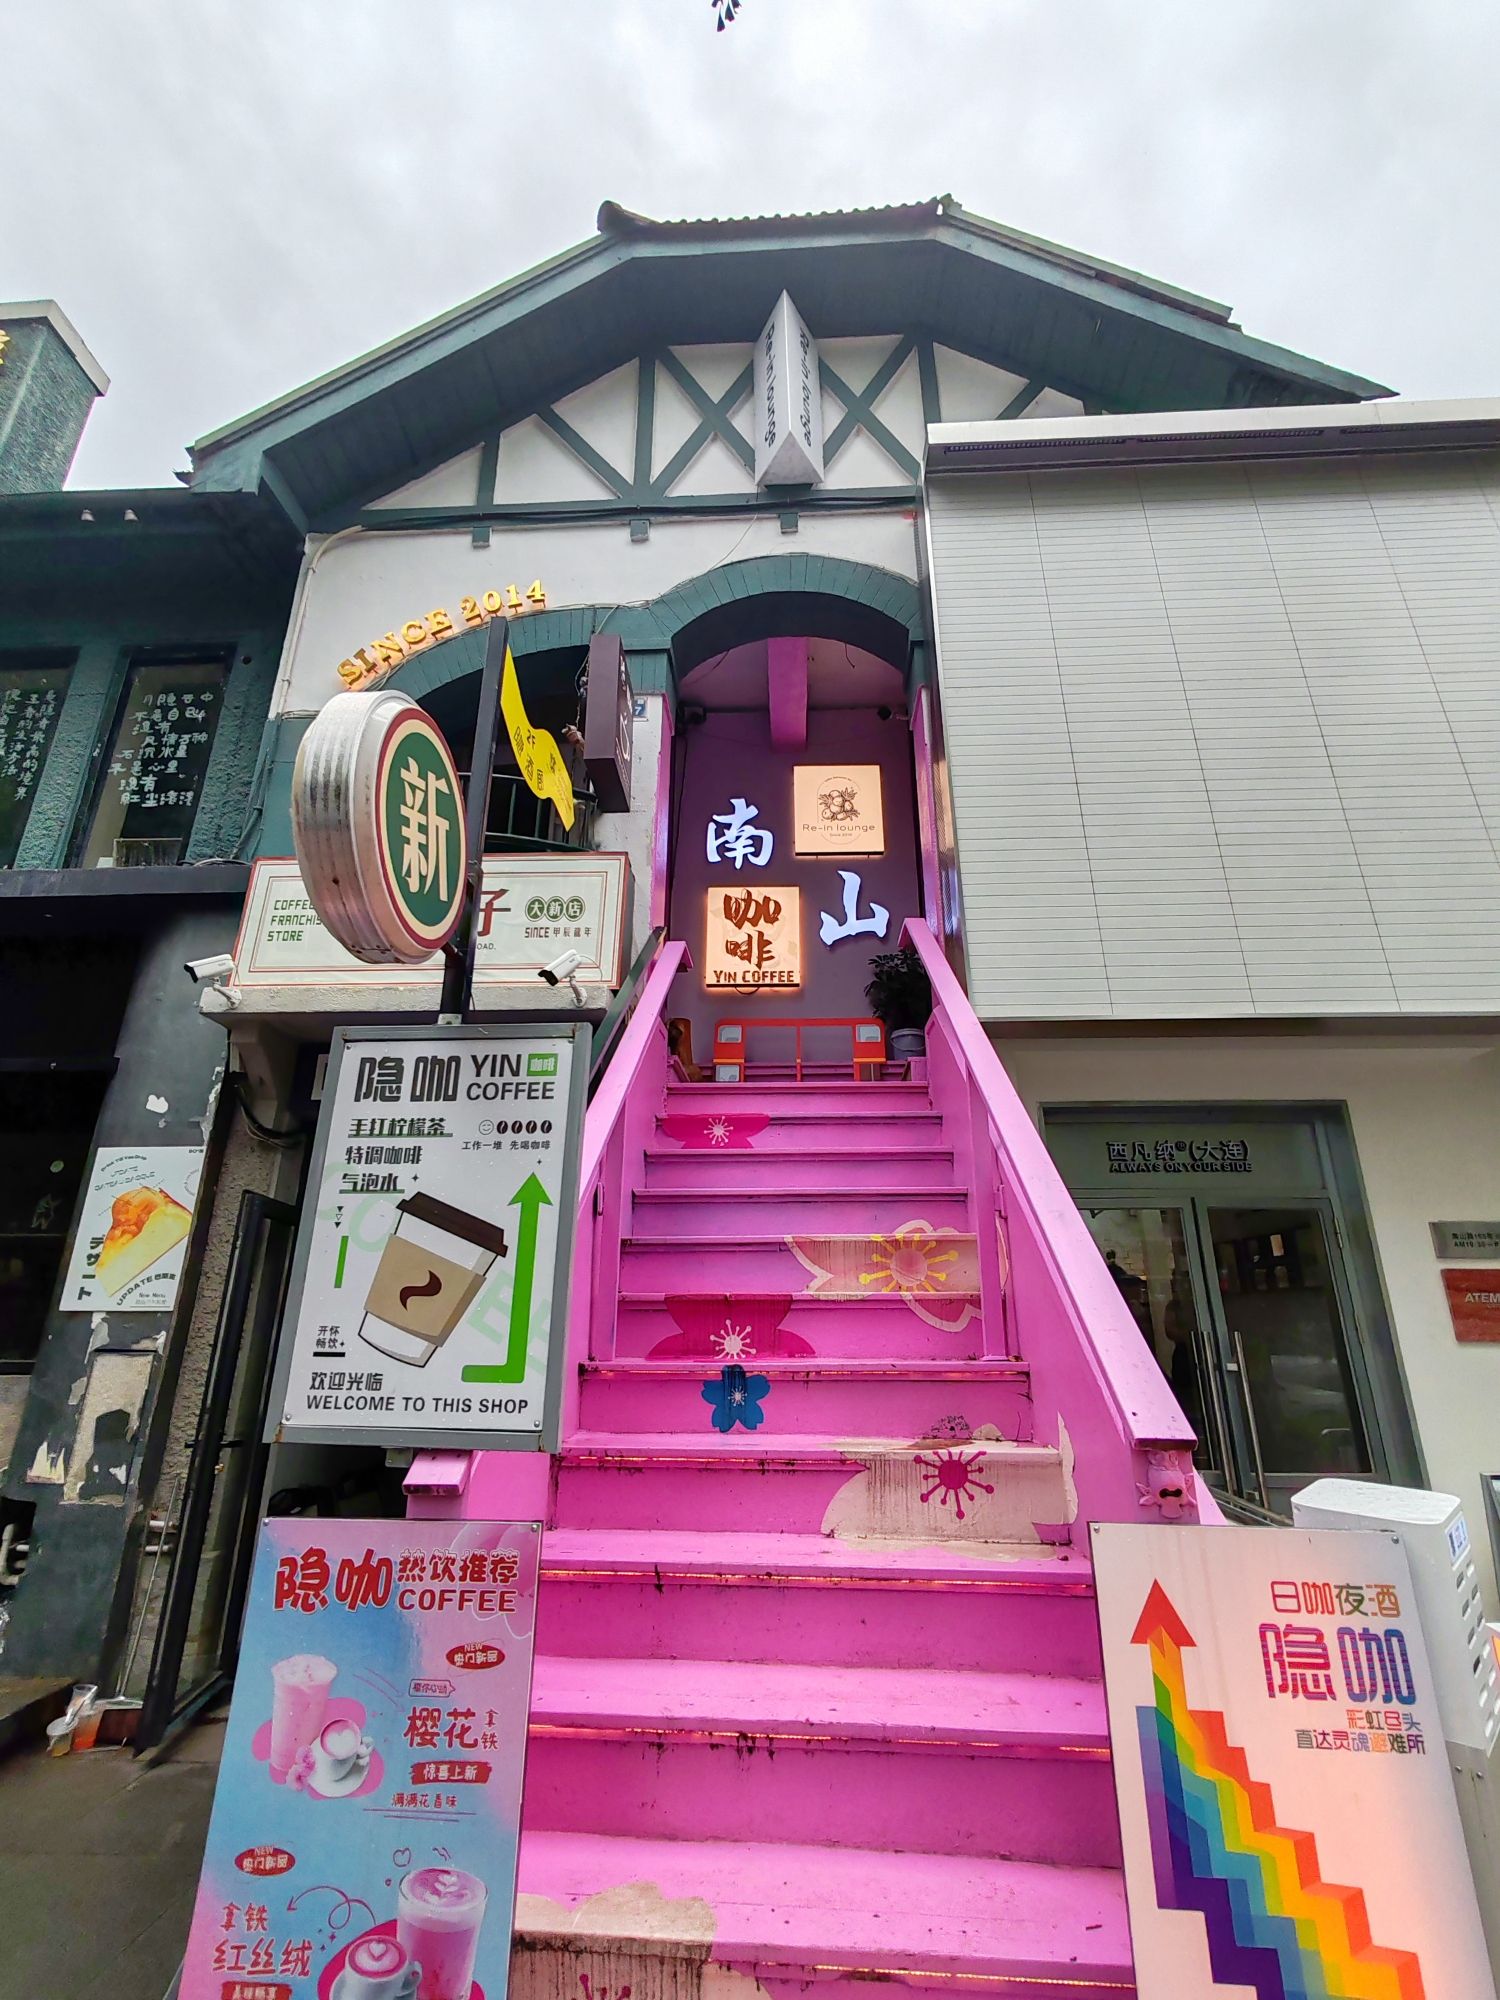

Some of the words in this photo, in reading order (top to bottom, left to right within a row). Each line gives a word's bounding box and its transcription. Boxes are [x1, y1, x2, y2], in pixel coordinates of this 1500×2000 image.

[337, 608, 453, 686] SINCE
[458, 579, 546, 623] 2014
[400, 755, 450, 902] 新
[706, 797, 774, 871] 南
[802, 823, 834, 832] Re-in
[836, 823, 876, 833] lounge
[528, 899, 582, 919] 大新店
[818, 869, 890, 946] 山
[266, 930, 304, 942] STORE
[524, 926, 550, 939] SINCE
[723, 887, 783, 970] 咖啡
[713, 969, 738, 984] YIN
[741, 969, 795, 984] COFFEE
[470, 1053, 523, 1078] YIN
[529, 1056, 556, 1073] 咖啡
[353, 1055, 462, 1103] 隐咖
[466, 1081, 556, 1101] COFFEE
[348, 1117, 447, 1136] 手打柠檬茶
[345, 1145, 423, 1165] 特调咖啡
[462, 1140, 503, 1151] 工作一堆
[509, 1140, 551, 1151] 先喝咖啡
[1110, 1162, 1162, 1173] ALWAYS
[1164, 1162, 1184, 1173] ON
[1185, 1162, 1222, 1173] YOUR
[1222, 1162, 1253, 1173] SIDE
[341, 1173, 399, 1192] 气泡水
[116, 1275, 153, 1306] UPDATE
[315, 1337, 338, 1349] 畅饮
[316, 1325, 341, 1337] 开怀
[309, 1371, 384, 1392] 欢迎光临
[306, 1395, 395, 1412] WELCOME
[402, 1396, 426, 1412] TO
[432, 1397, 472, 1413] THIS
[478, 1398, 529, 1414] SHOP
[397, 1547, 519, 1584] 热饮推荐
[273, 1545, 394, 1614] 隐咖
[398, 1588, 517, 1613] COFFEE
[1270, 1580, 1401, 1619] 日咖夜酒
[464, 1643, 484, 1653] NEW
[1258, 1622, 1417, 1706] 隐咖
[403, 1705, 480, 1749] 樱花
[480, 1708, 500, 1750] 拿铁
[1346, 1708, 1423, 1733] 彩虹尽头
[1294, 1728, 1427, 1756] 直达灵魂避难所
[422, 1763, 478, 1781] 惊喜上新
[219, 1901, 268, 1932] 拿铁
[212, 1936, 313, 1978] 红丝绒
